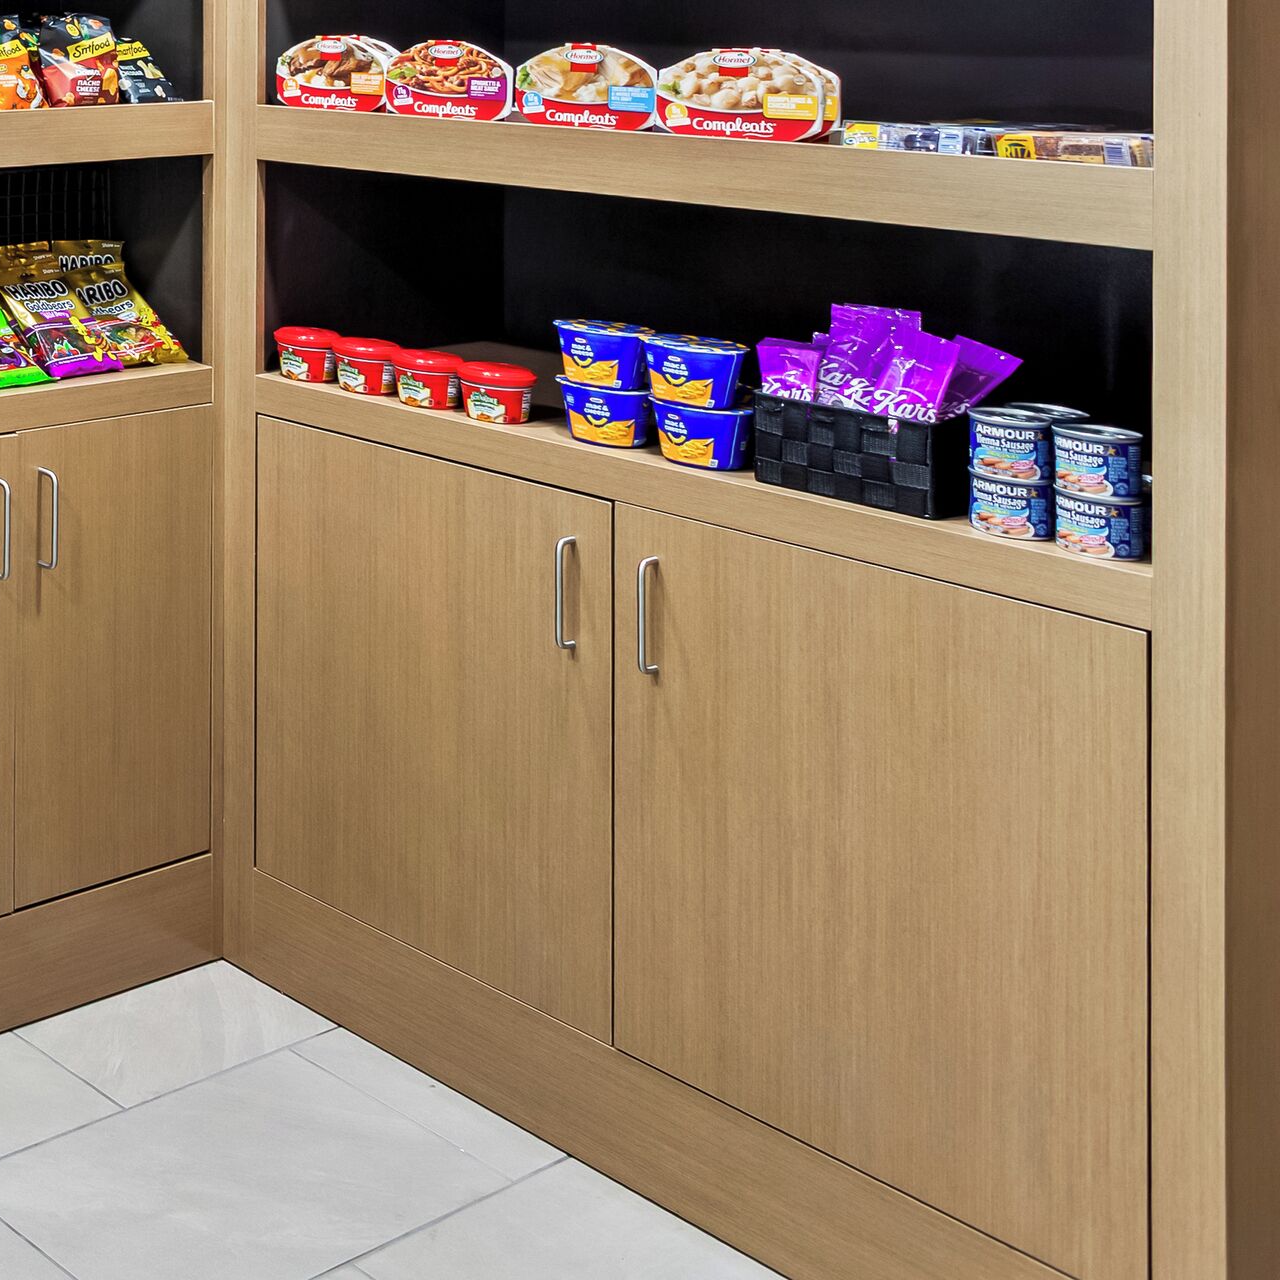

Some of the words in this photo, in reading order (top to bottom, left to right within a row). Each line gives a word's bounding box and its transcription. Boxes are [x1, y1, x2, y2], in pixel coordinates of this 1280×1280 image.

[569, 51, 600, 62] Hormel
[716, 54, 754, 65] Hormel
[301, 93, 357, 109] Compleats
[414, 101, 476, 118] Compleats
[545, 109, 617, 126] Compleats
[692, 117, 774, 136] Compleats
[7, 280, 69, 300] HARIBO
[26, 301, 75, 312] Goldbears
[976, 423, 1035, 440] ARMOUR
[1001, 439, 1035, 454] Sausage
[1070, 451, 1104, 467] Sausage
[973, 479, 1027, 498] ARMOUR
[994, 495, 1027, 509] Sausage
[1071, 511, 1105, 528] Sausage
